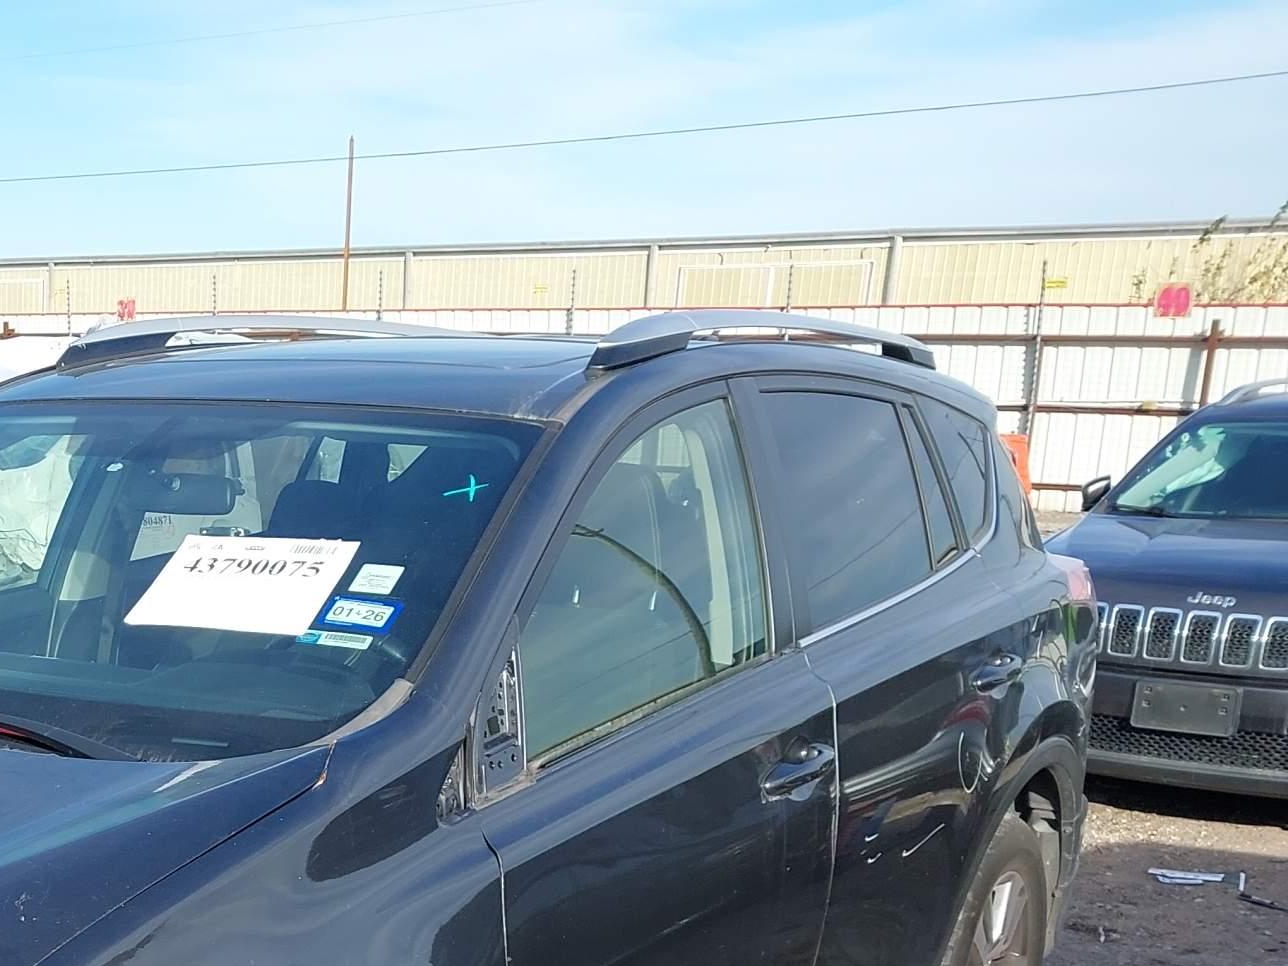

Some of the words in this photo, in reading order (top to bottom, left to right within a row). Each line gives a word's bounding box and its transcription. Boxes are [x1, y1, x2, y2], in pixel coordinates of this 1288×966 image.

[184, 557, 325, 577] 43790075
[1187, 592, 1236, 608] Jeep
[332, 606, 354, 617] 01
[362, 609, 386, 621] 26
